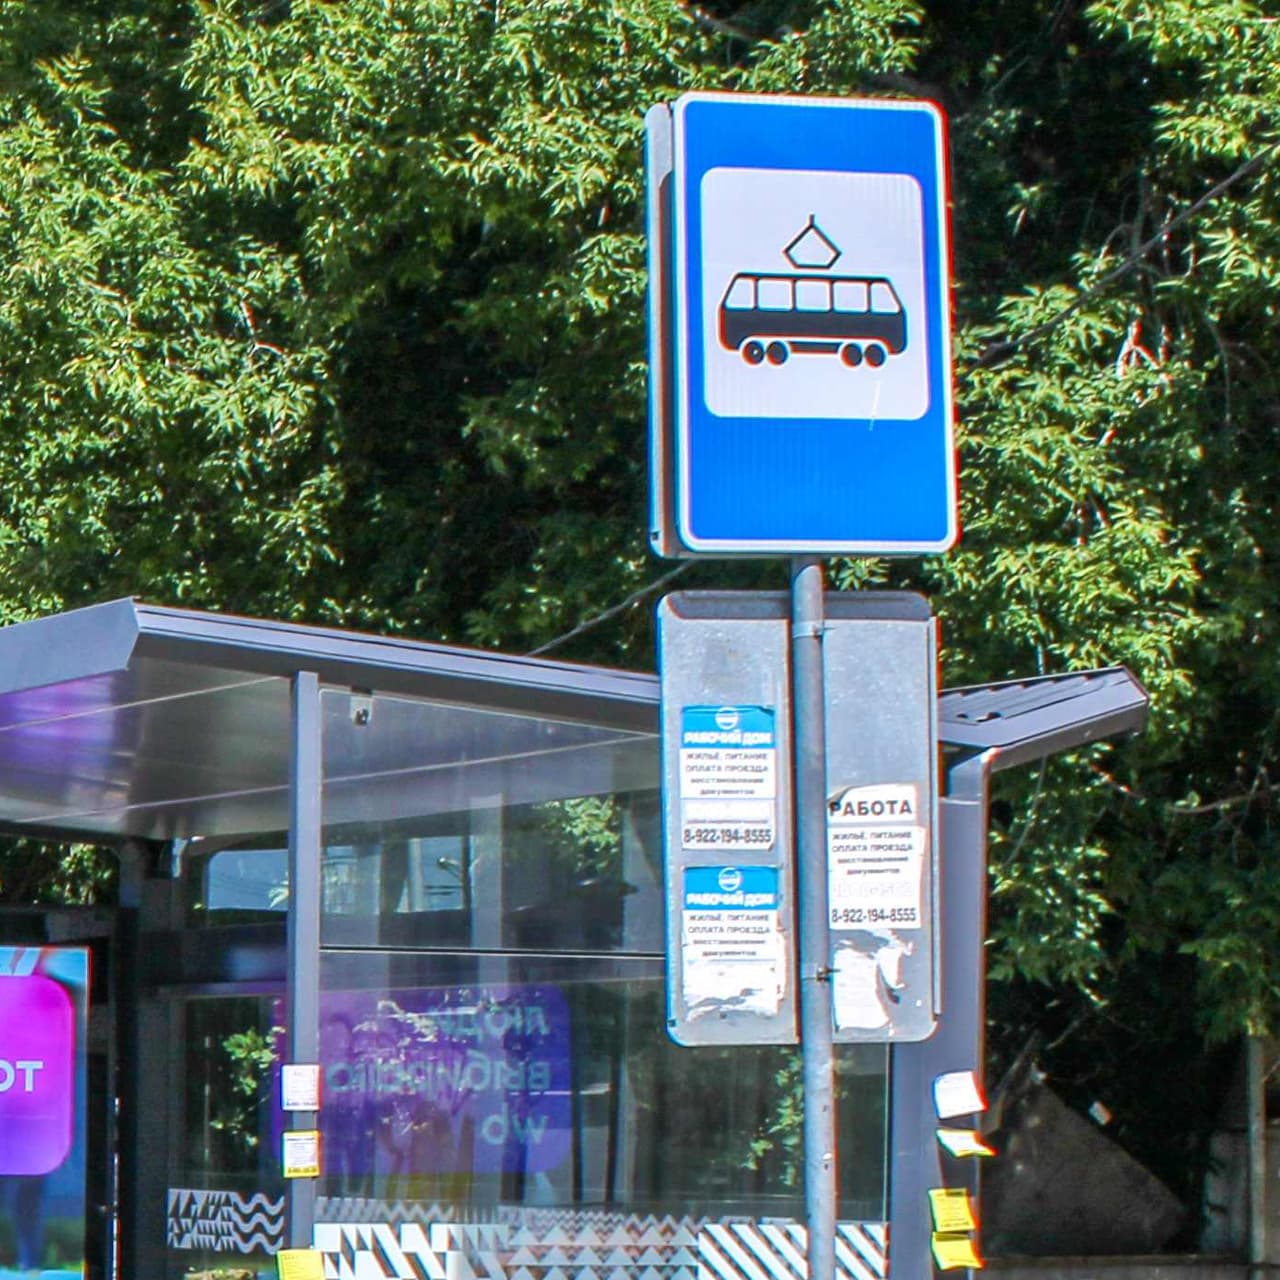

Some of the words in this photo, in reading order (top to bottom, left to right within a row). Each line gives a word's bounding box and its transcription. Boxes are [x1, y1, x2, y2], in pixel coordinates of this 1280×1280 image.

[742, 732, 771, 746] ДОМ
[829, 799, 913, 817] РАБОТА
[683, 828, 772, 843] 8-922-194-8555
[744, 893, 775, 907] ДОМ
[831, 908, 917, 923] 8-922-194-8555
